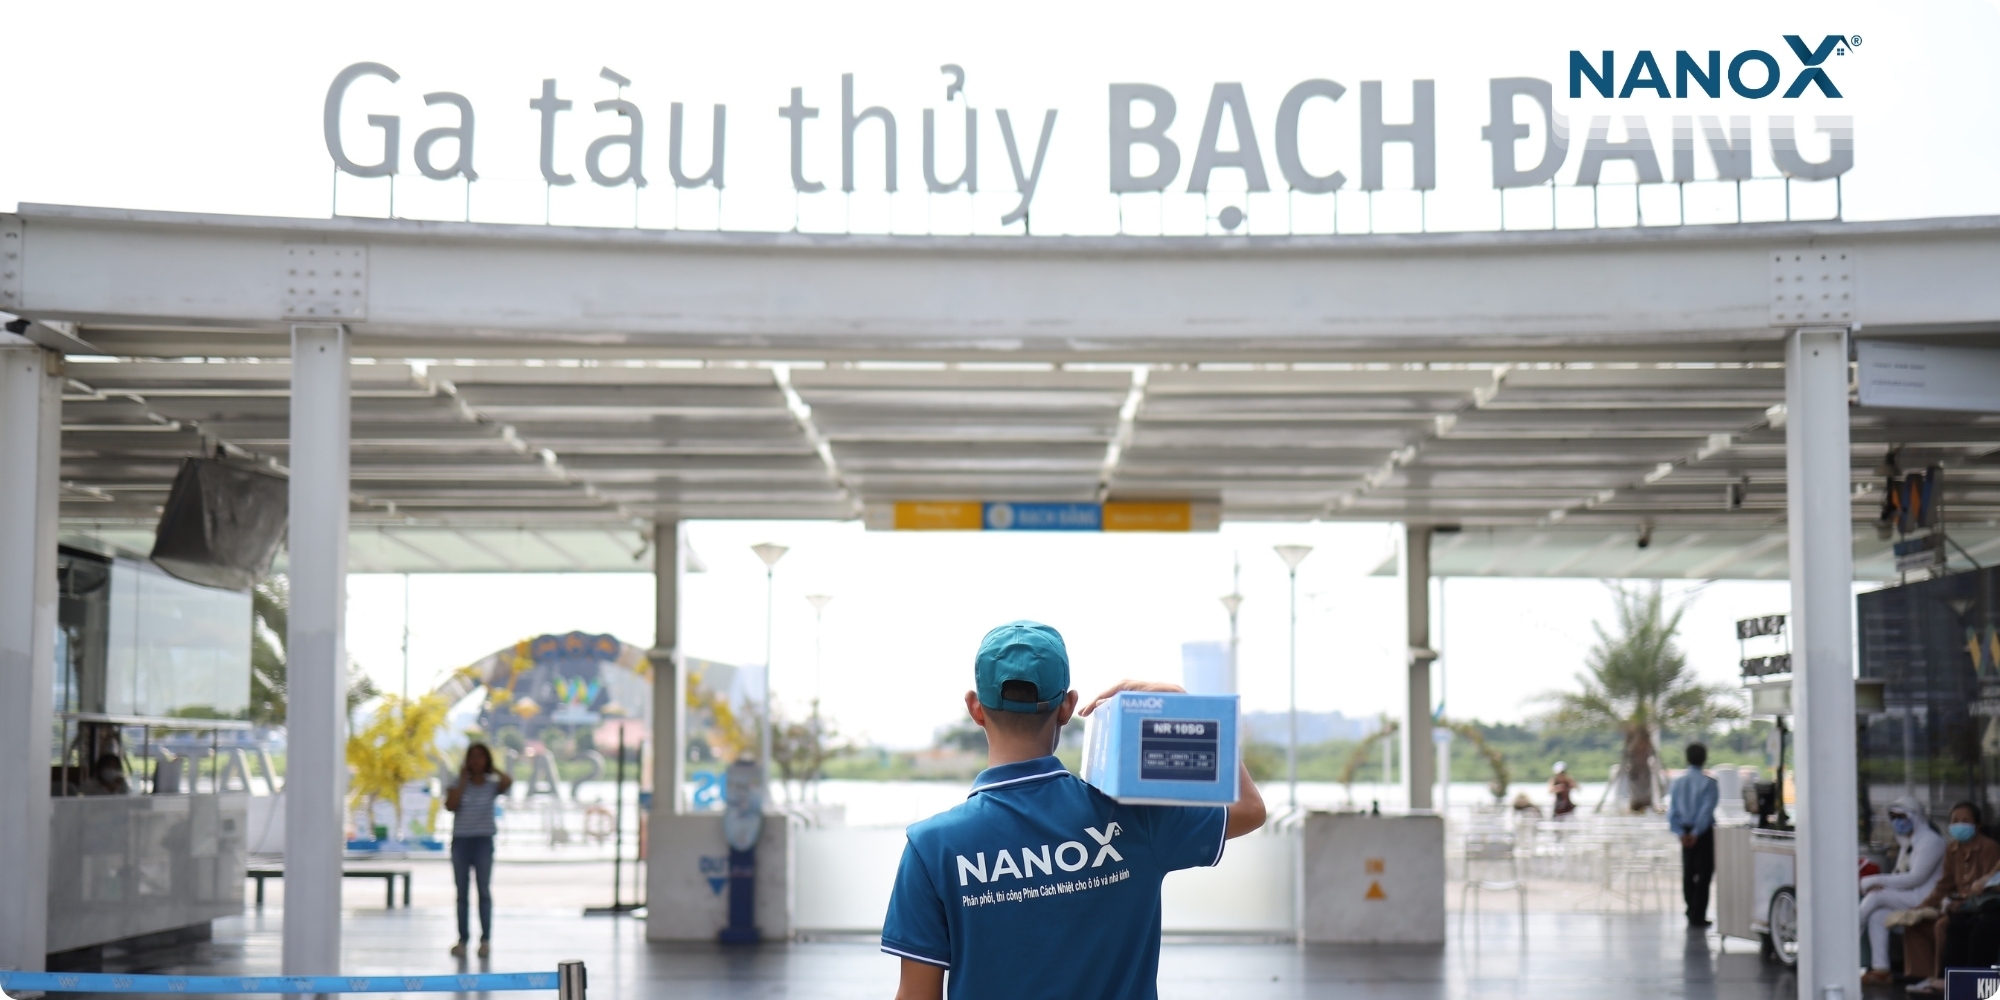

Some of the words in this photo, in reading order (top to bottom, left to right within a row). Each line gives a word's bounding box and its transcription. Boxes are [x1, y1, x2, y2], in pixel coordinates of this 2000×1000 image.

[323, 61, 478, 182] Ga
[529, 66, 727, 189] tàu
[778, 63, 1058, 227] thủy
[1109, 77, 1436, 231] BẠCH
[1154, 722, 1172, 735] NR
[956, 822, 1124, 886] NANOX
[962, 895, 979, 907] Phân
[979, 890, 996, 907] phối,
[996, 890, 1005, 902] thi
[1006, 889, 1023, 902] công
[1022, 887, 1039, 899] Phim
[1040, 884, 1057, 896] Cách
[1056, 881, 1075, 894] Nhiệt
[1075, 880, 1087, 891] cho
[1088, 877, 1093, 889] ô
[1093, 876, 1100, 888] tô
[1101, 874, 1108, 886] và
[1109, 872, 1119, 883] nhà
[1119, 868, 1130, 880] kính
